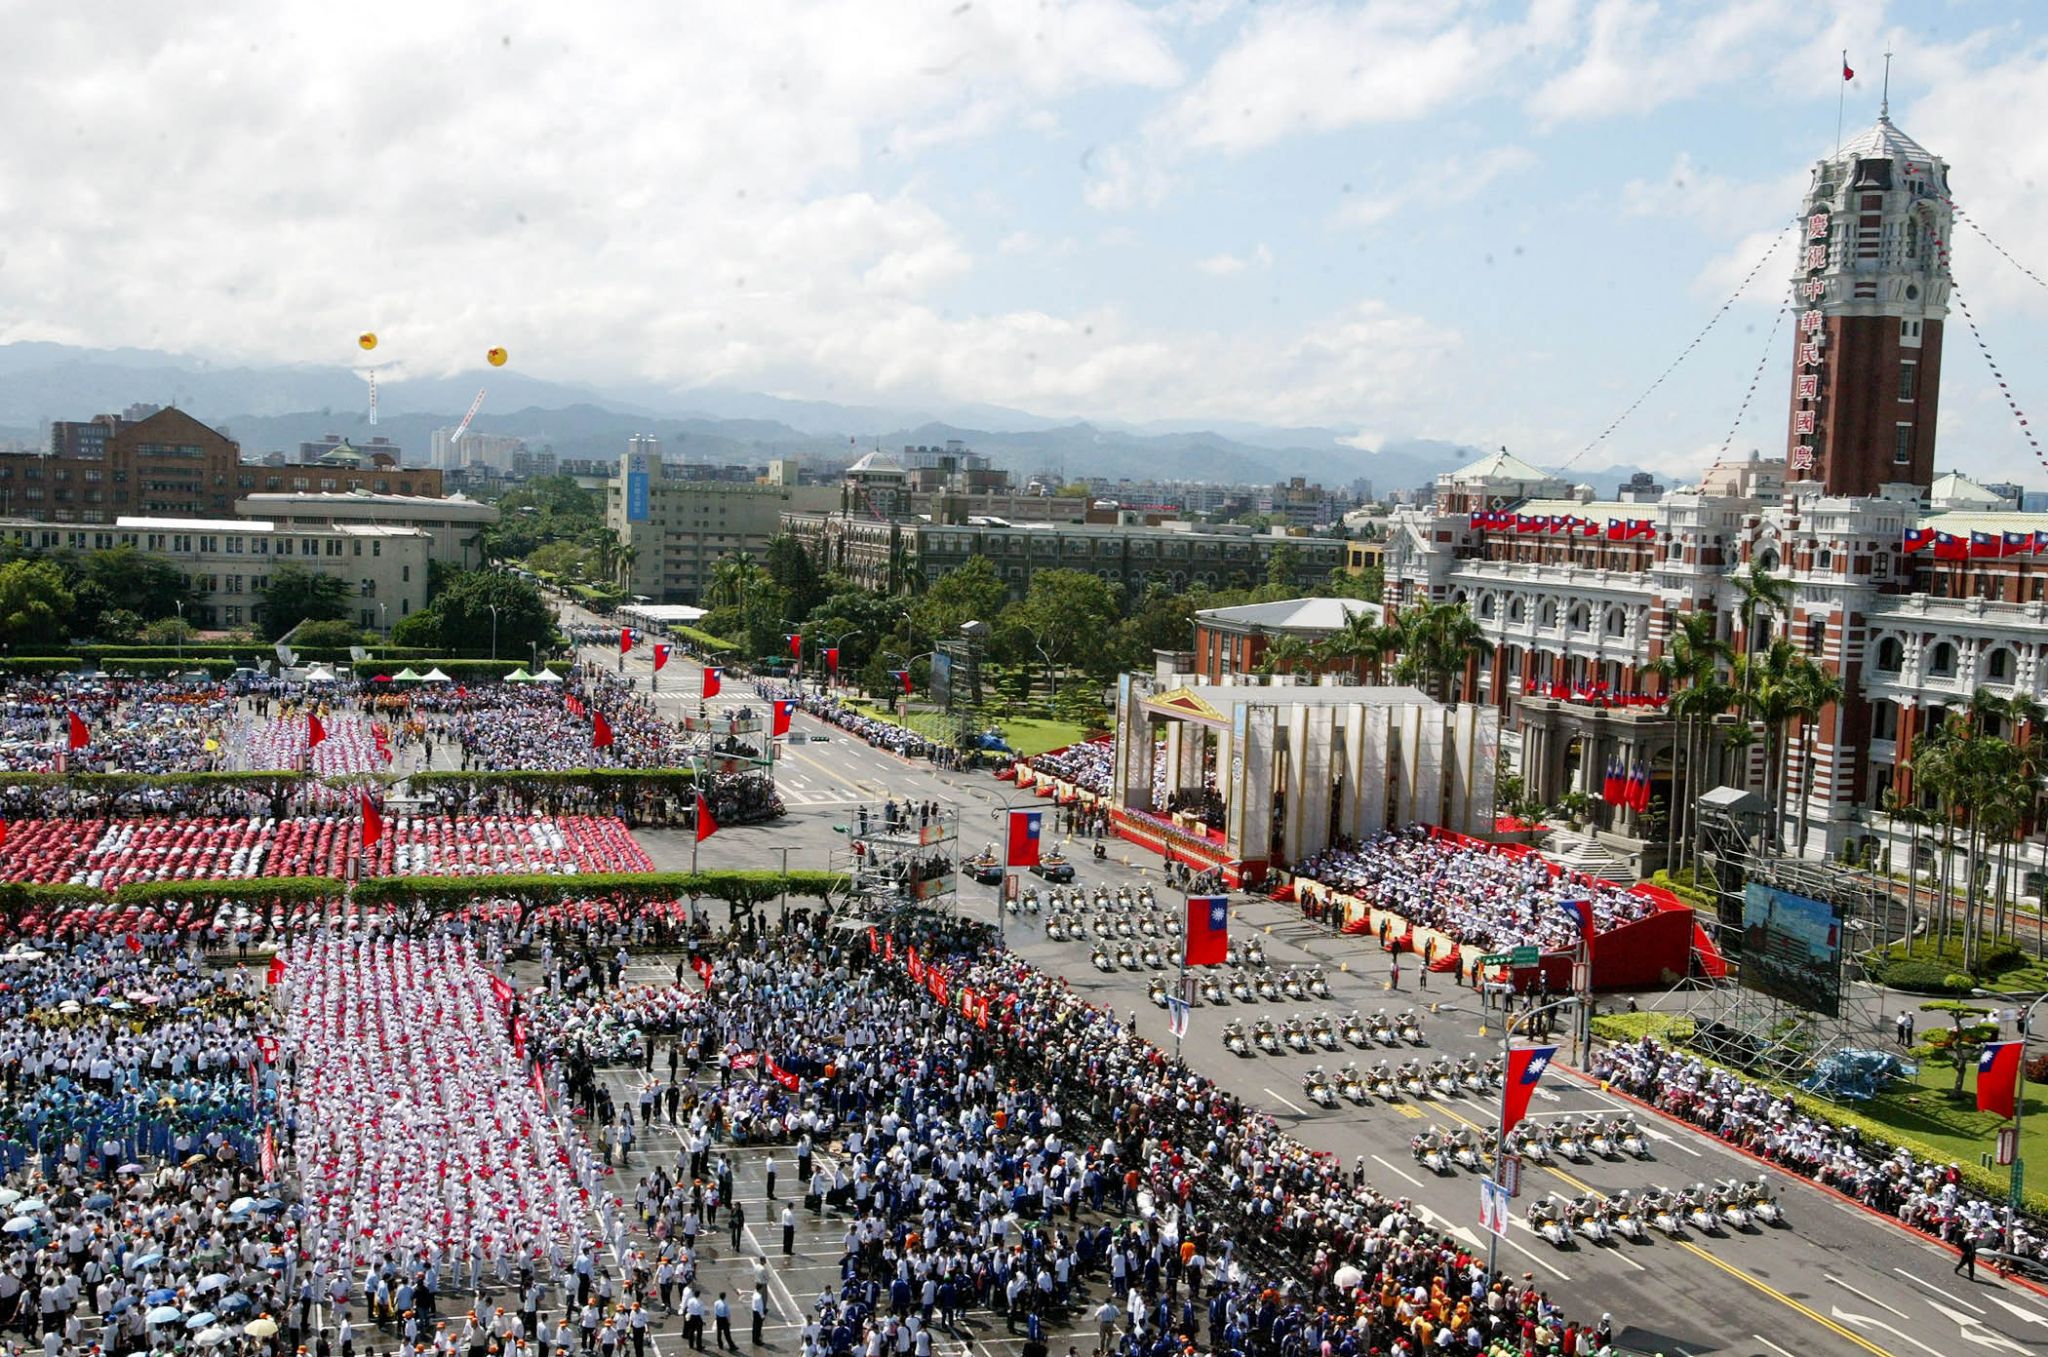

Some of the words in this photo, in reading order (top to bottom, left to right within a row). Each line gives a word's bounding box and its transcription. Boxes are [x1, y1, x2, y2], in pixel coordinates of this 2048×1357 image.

[1791, 213, 1828, 470] 慶祝中華民國國慶
